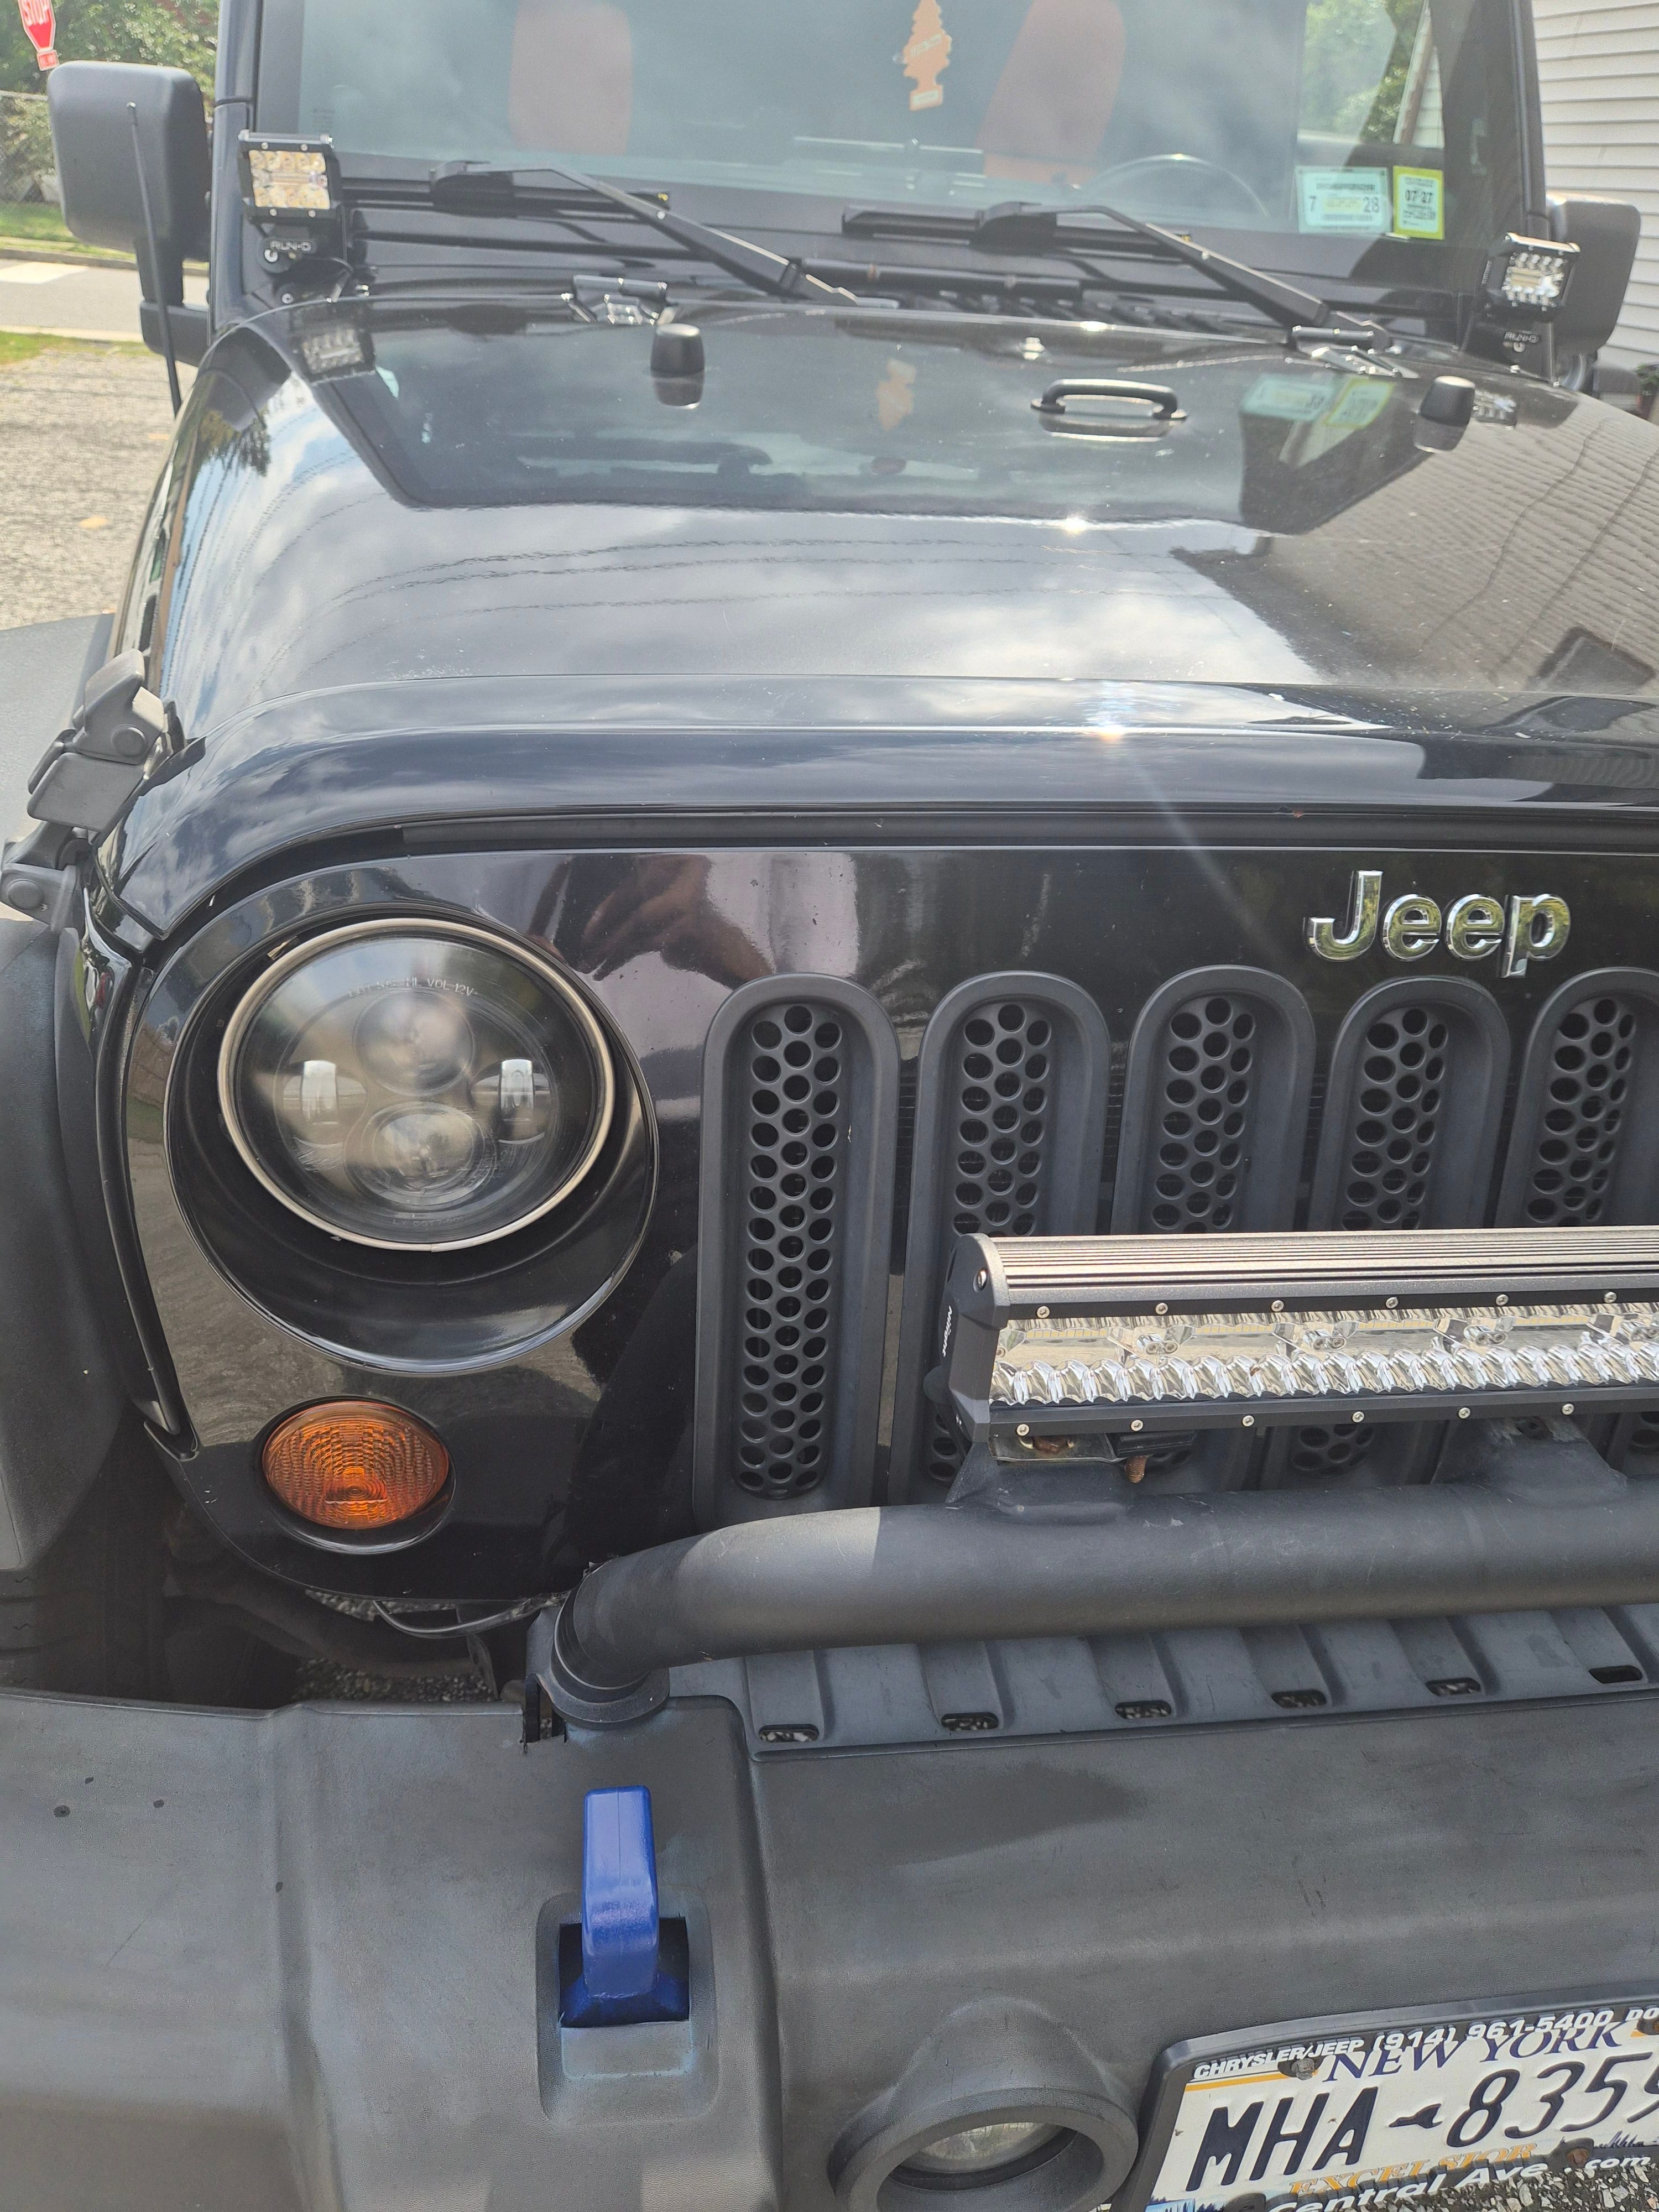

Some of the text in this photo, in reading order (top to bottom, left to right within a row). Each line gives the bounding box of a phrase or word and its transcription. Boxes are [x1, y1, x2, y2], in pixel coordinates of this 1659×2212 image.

[1308, 195, 1317, 212] 7
[1363, 196, 1379, 213] 28
[1303, 870, 1571, 978] Jeep
[427, 977, 450, 991] VOL
[1193, 2039, 1365, 2079] CHRYSLER/JEEP
[1373, 2026, 1457, 2052] (914)
[1465, 2010, 1614, 2042] 961-5400
[1322, 2018, 1627, 2083] NEW YORK
[1185, 2086, 1379, 2192] MHA
